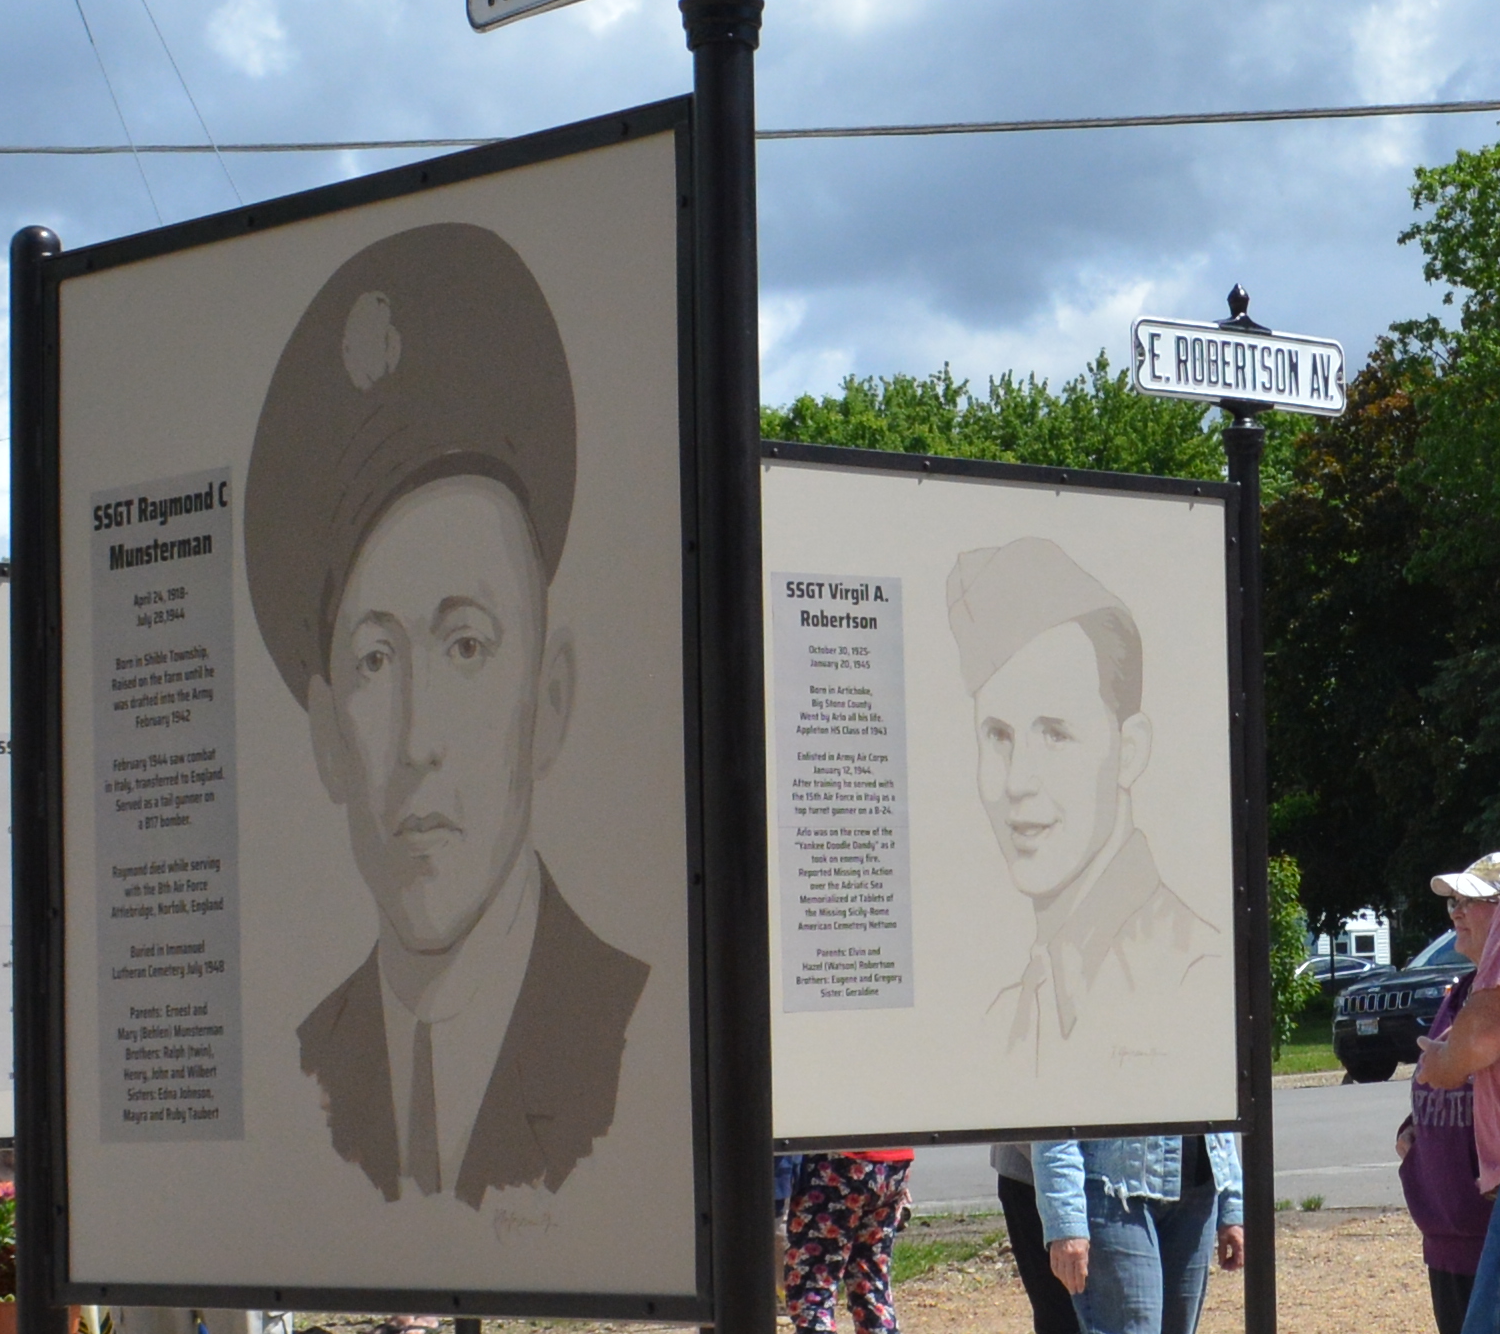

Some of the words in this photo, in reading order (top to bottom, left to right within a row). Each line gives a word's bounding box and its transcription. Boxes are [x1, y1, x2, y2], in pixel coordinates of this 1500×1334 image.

[1149, 332, 1171, 382] E.
[1175, 335, 1300, 397] ROBERTSON
[1310, 352, 1334, 401] AV.
[93, 498, 134, 532] SSGT
[137, 481, 214, 527] Raymond
[218, 480, 228, 508] C
[109, 534, 213, 571] Munsterman
[786, 580, 825, 600] SSGT
[828, 582, 869, 606] Virgil
[873, 585, 889, 603] A.
[800, 609, 878, 630] Robertson
[808, 644, 837, 655] October
[810, 659, 839, 671] January
[809, 684, 827, 695] Born
[828, 687, 836, 695] in
[811, 698, 824, 710] Big
[824, 698, 846, 709] Stone
[847, 699, 872, 711] County
[799, 711, 819, 721] Went
[820, 711, 831, 724] by
[831, 712, 847, 722] Arlo
[847, 712, 857, 722] all
[857, 712, 869, 722] his
[795, 724, 829, 736] Appleton
[830, 725, 841, 735] HS
[841, 725, 861, 735] Class
[861, 725, 869, 736] of
